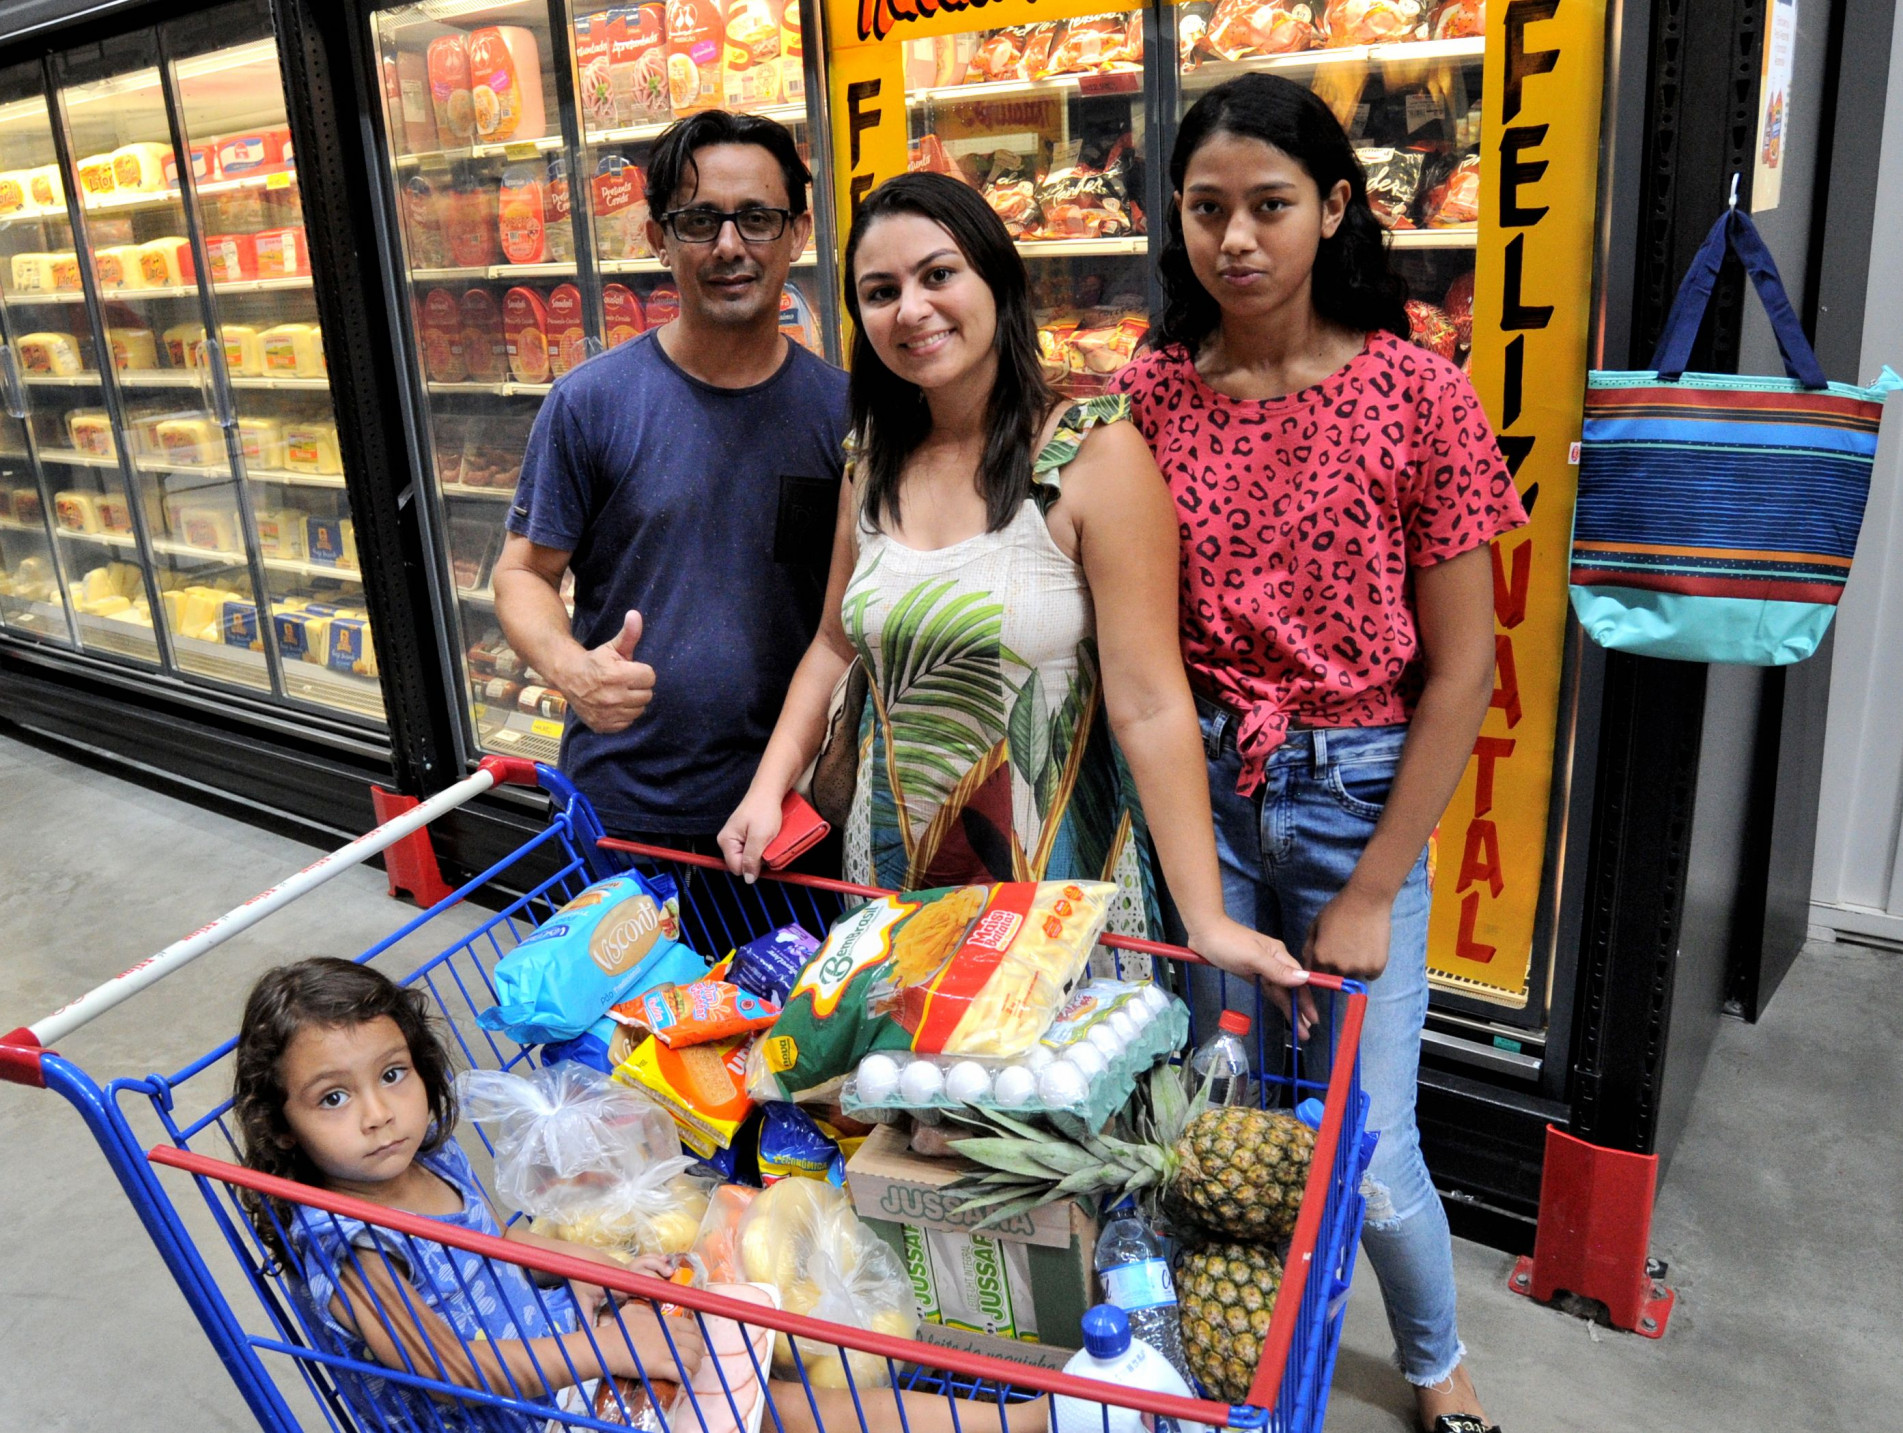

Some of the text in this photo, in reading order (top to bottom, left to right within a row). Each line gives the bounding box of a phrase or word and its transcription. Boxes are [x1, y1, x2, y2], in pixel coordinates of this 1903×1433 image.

[1455, 0, 1561, 964] FELIZ NATAL
[593, 901, 659, 971] Visconti
